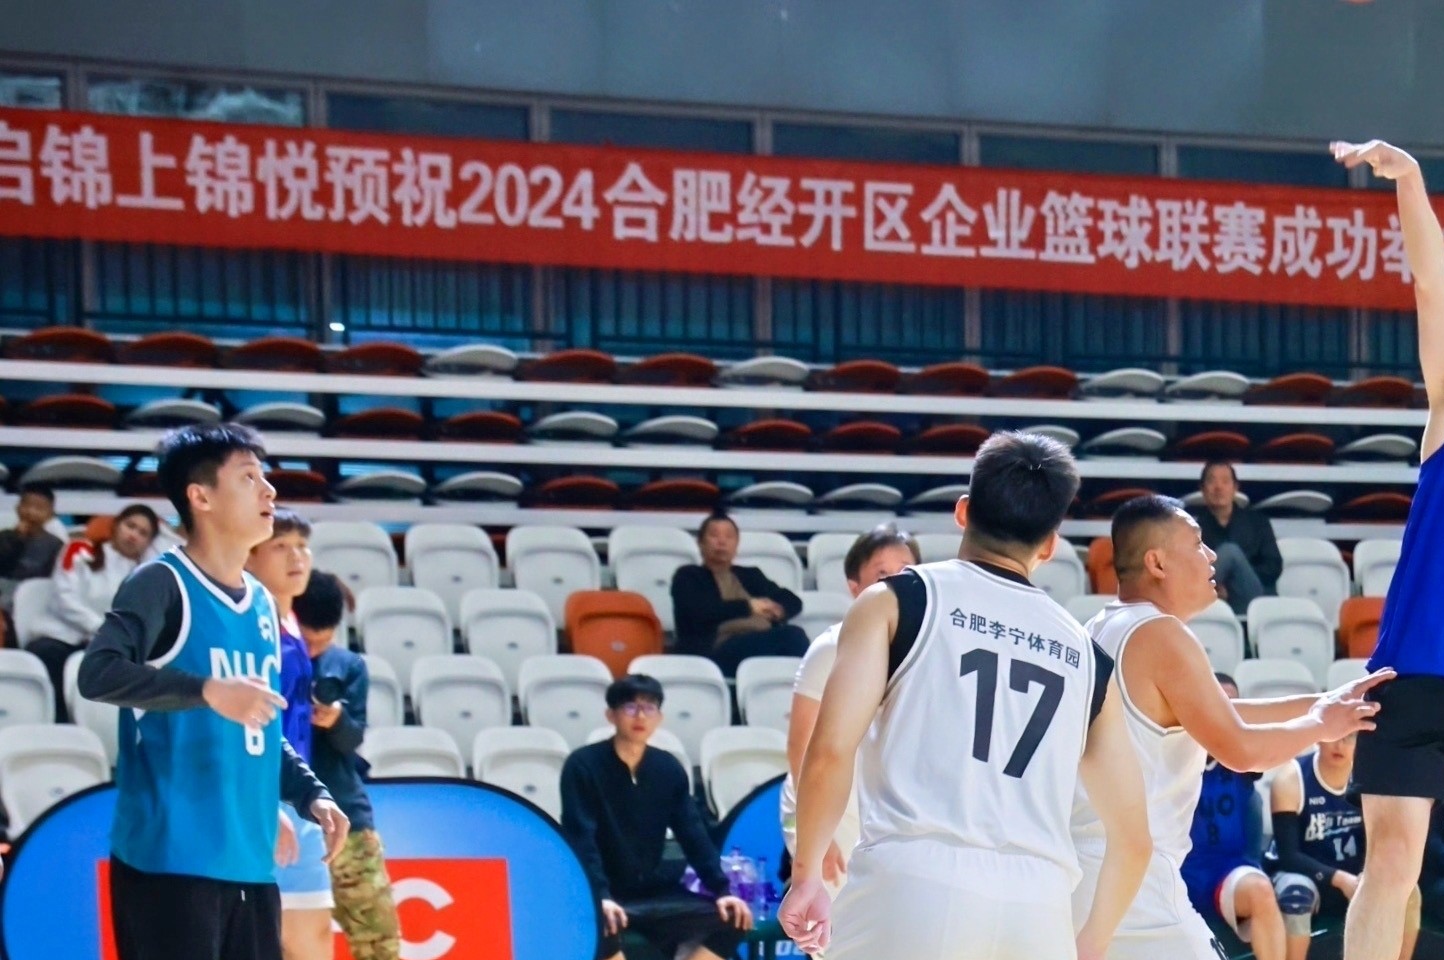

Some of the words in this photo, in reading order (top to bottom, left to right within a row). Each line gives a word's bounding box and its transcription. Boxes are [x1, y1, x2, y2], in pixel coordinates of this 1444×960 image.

[949, 607, 1081, 669] 合肥李宁体育园
[959, 647, 1065, 779] 17
[1333, 834, 1357, 861] 14
